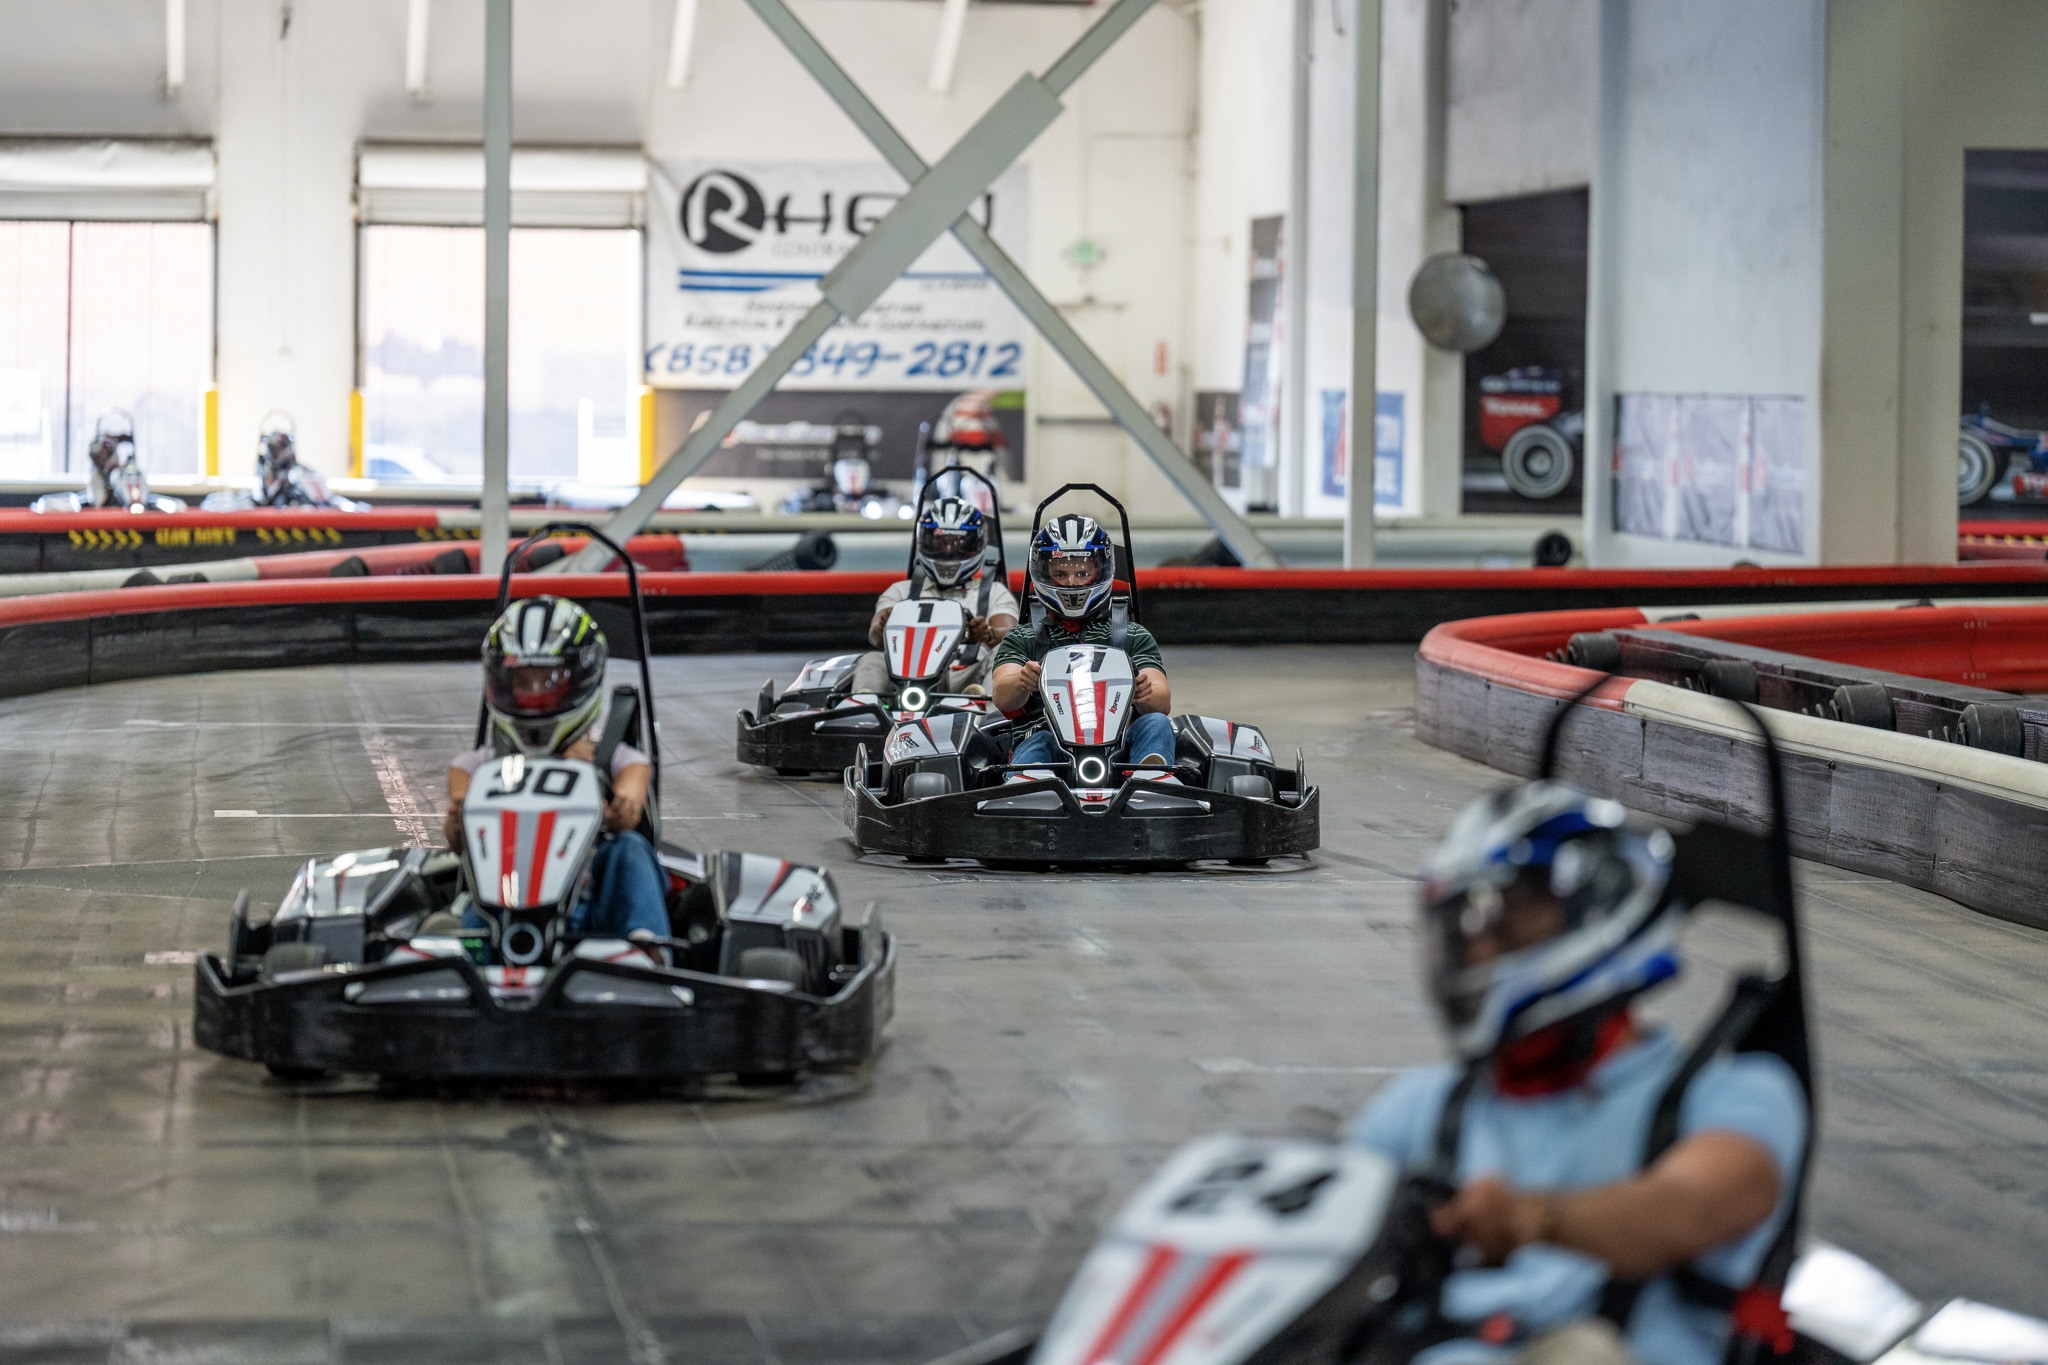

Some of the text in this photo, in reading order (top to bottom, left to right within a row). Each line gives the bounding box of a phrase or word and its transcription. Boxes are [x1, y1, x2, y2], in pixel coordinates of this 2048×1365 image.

[645, 342, 770, 375] (858
[917, 603, 934, 623] 1
[1109, 691, 1121, 714] K1SPEED
[486, 767, 580, 798] 30
